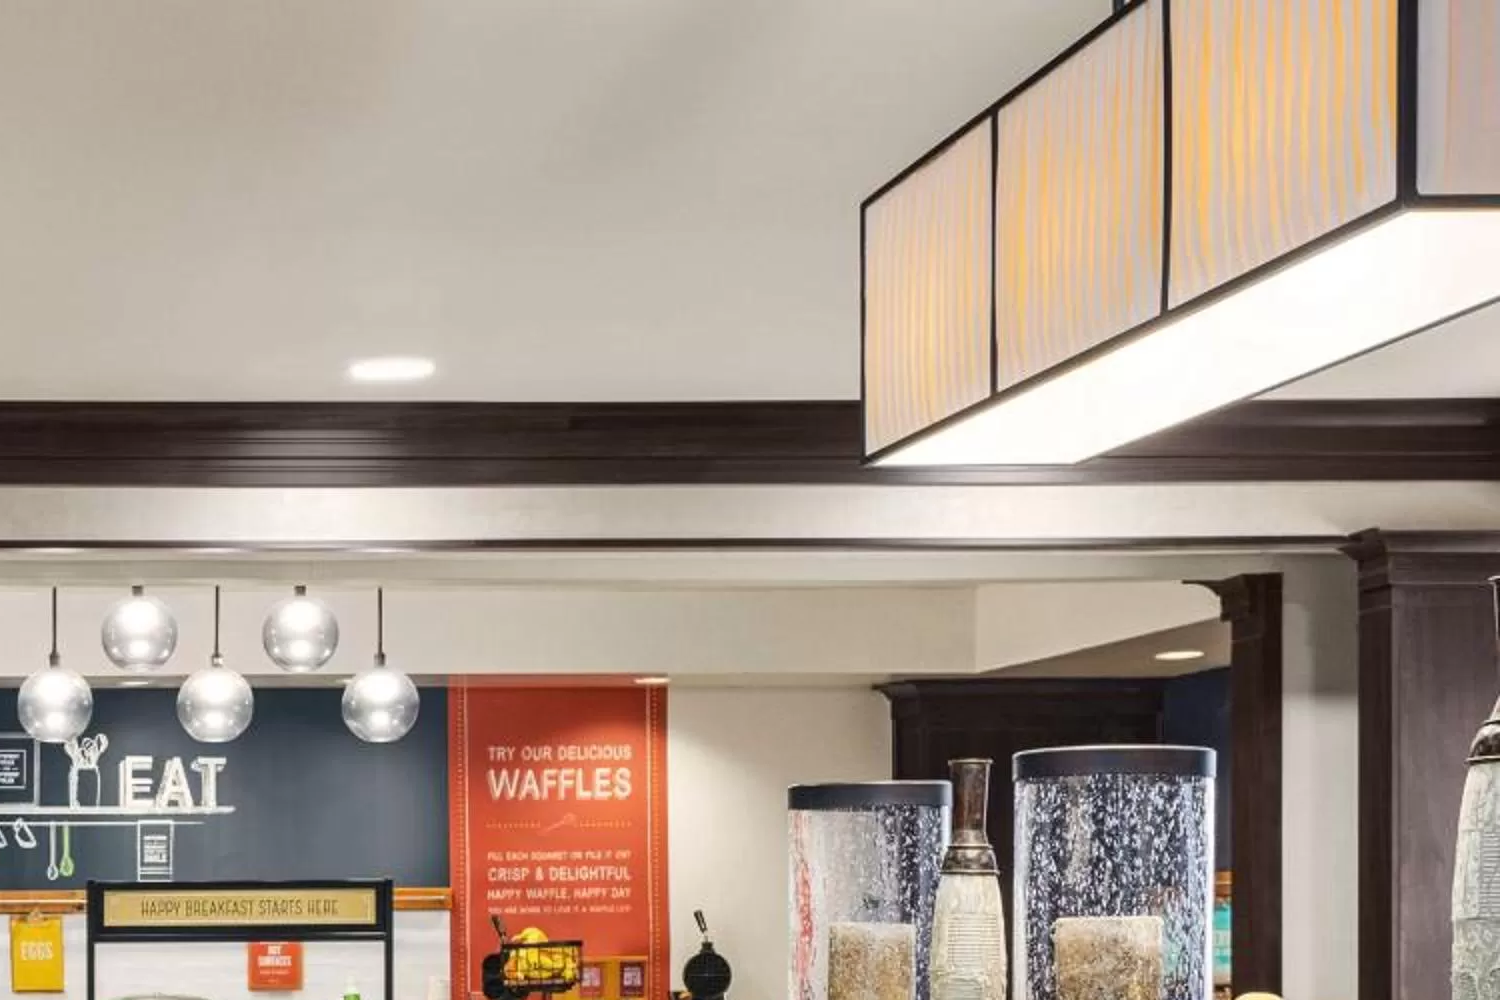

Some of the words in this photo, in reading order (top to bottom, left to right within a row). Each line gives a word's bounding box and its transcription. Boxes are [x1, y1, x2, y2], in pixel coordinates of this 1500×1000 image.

[488, 745, 516, 761] TRY
[521, 745, 553, 761] OUR
[557, 744, 632, 761] DELICIOUS
[119, 755, 227, 812] EAT
[486, 767, 632, 801] WAFFLES
[506, 851, 529, 861] EACH
[487, 867, 529, 882] CRISP
[535, 866, 544, 881] &
[548, 865, 631, 881] DELIGHTFUL
[487, 889, 522, 900] HAPPY
[573, 887, 607, 900] HAPPY
[611, 886, 632, 899] DAY
[141, 898, 181, 917] HAPPY
[185, 898, 254, 917] BREAKFAST
[258, 898, 303, 916] STARTS
[307, 898, 340, 916] HERE
[20, 941, 54, 961] EGGS
